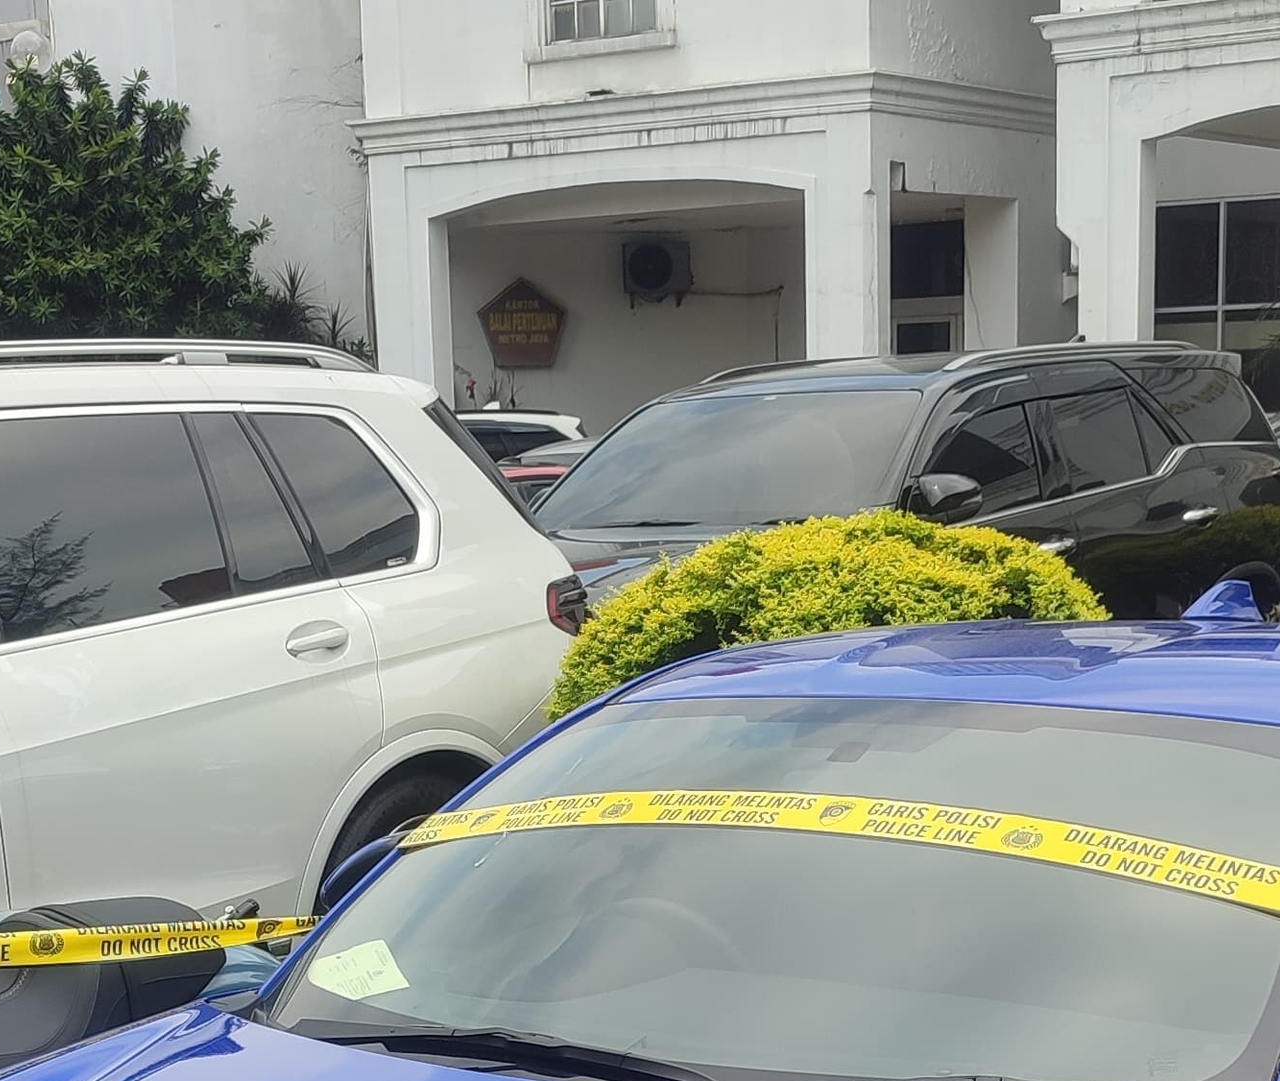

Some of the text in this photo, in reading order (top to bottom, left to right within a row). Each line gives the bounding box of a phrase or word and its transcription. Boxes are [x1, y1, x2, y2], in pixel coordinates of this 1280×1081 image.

[505, 299, 539, 309] KANTOR
[489, 312, 557, 331] BALAI PERTEMUAN
[498, 333, 527, 344] METRO
[507, 796, 604, 817] GARIS POLISI
[648, 793, 818, 811] DILARANG MELINTAS
[496, 810, 587, 831] POLICE LINE
[656, 808, 780, 825] DO NOT CROSS
[866, 802, 1002, 831] GARIS POLISI
[860, 819, 982, 846] POLICE LINE
[1063, 828, 1169, 862] DILARANG
[1079, 850, 1241, 897] DO NOT CROSS
[101, 935, 221, 957] DO NOT CROSS
